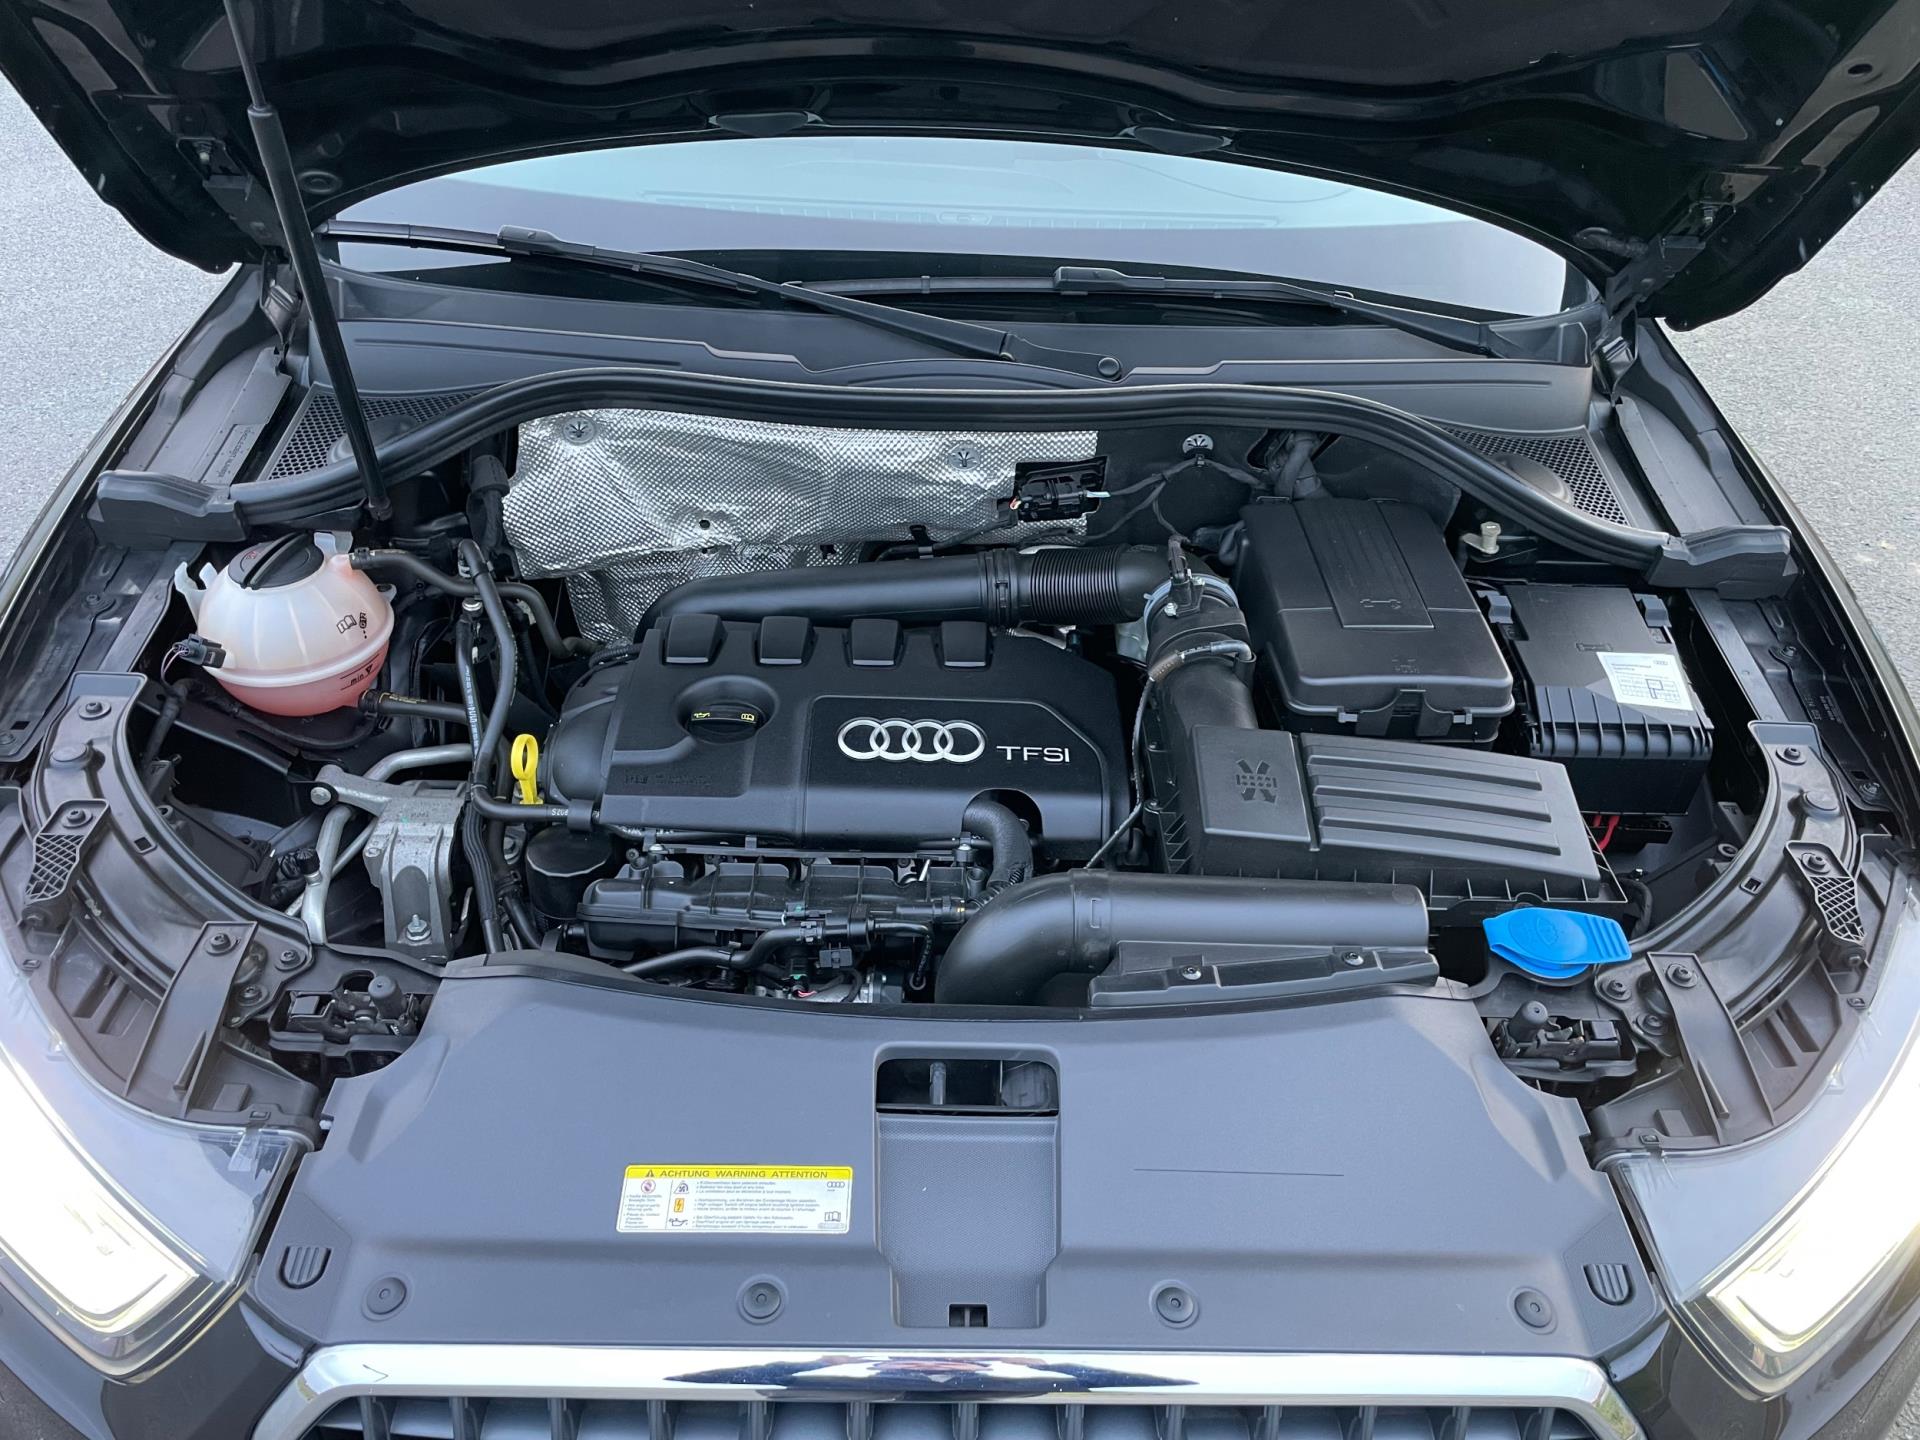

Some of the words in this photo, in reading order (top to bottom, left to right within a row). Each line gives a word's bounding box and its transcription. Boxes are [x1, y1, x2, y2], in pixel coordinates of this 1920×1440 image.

[351, 673, 365, 686] min
[996, 745, 1070, 762] TFSI
[659, 1169, 710, 1178] ACHTUNG
[715, 1169, 766, 1178] WARNING
[771, 1170, 828, 1179] ATTENTION
